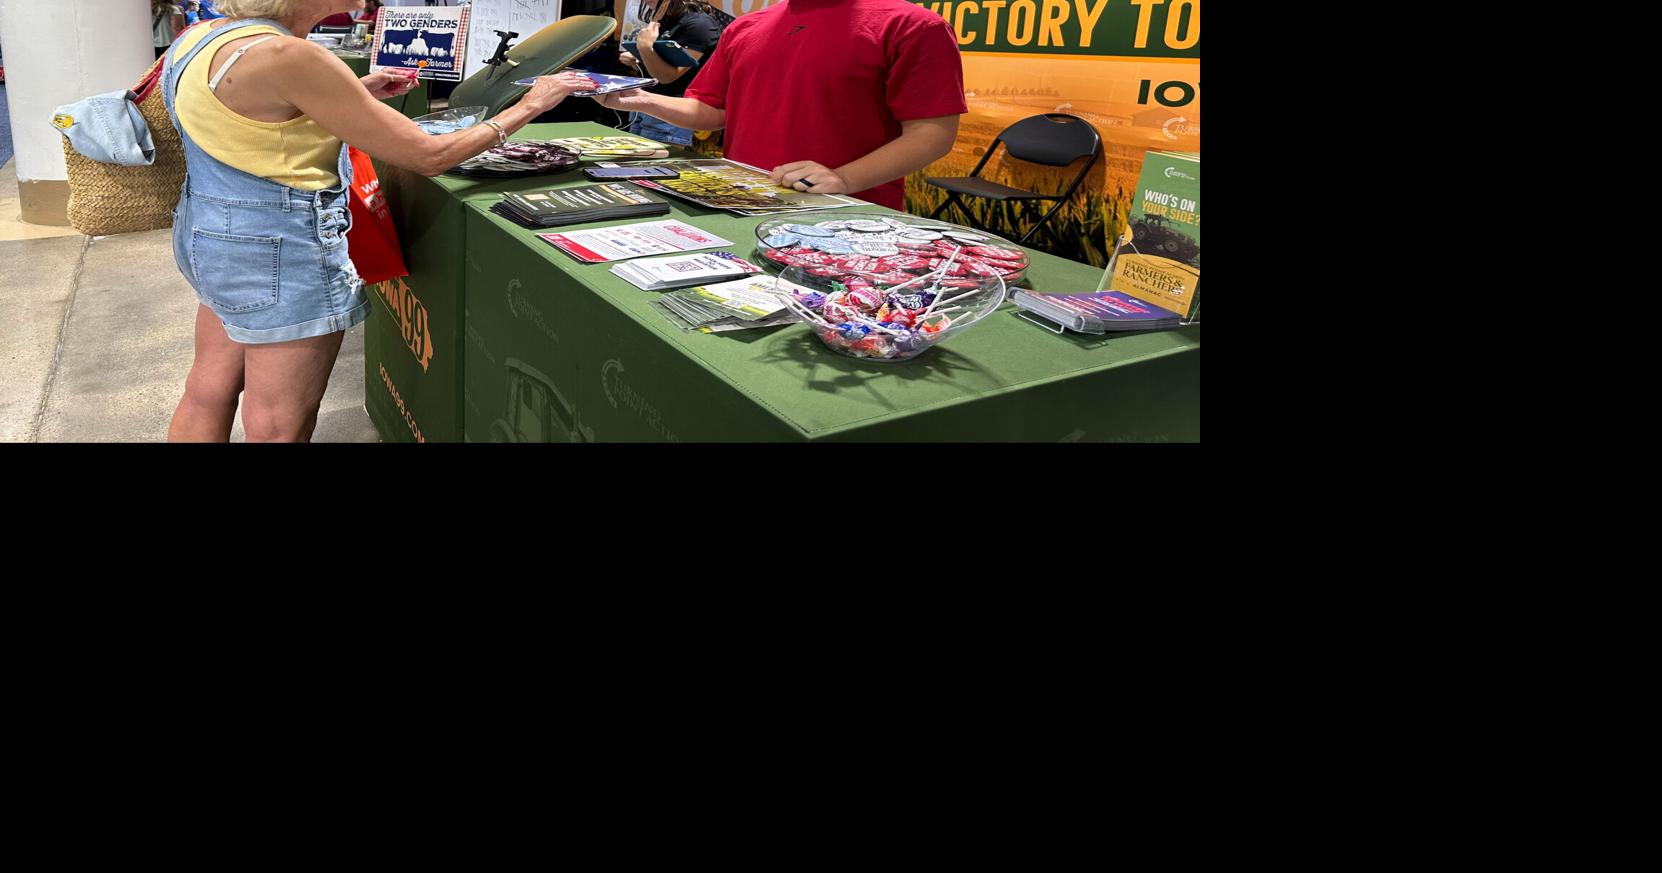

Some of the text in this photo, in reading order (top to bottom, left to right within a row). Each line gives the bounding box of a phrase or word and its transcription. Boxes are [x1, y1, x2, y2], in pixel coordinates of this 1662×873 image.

[384, 19, 458, 29] TWO GENDERS
[385, 11, 404, 19] There
[419, 11, 434, 21] only
[1130, 0, 1200, 49] TO
[1137, 79, 1200, 107] IO
[1142, 200, 1200, 226] YOUR SIDE?
[1144, 189, 1196, 213] WHO'S ON
[1125, 262, 1173, 286] FARMERS
[1132, 284, 1162, 297] ALMANAC
[403, 287, 425, 363] 99
[379, 361, 425, 443] IOWA99.COM
